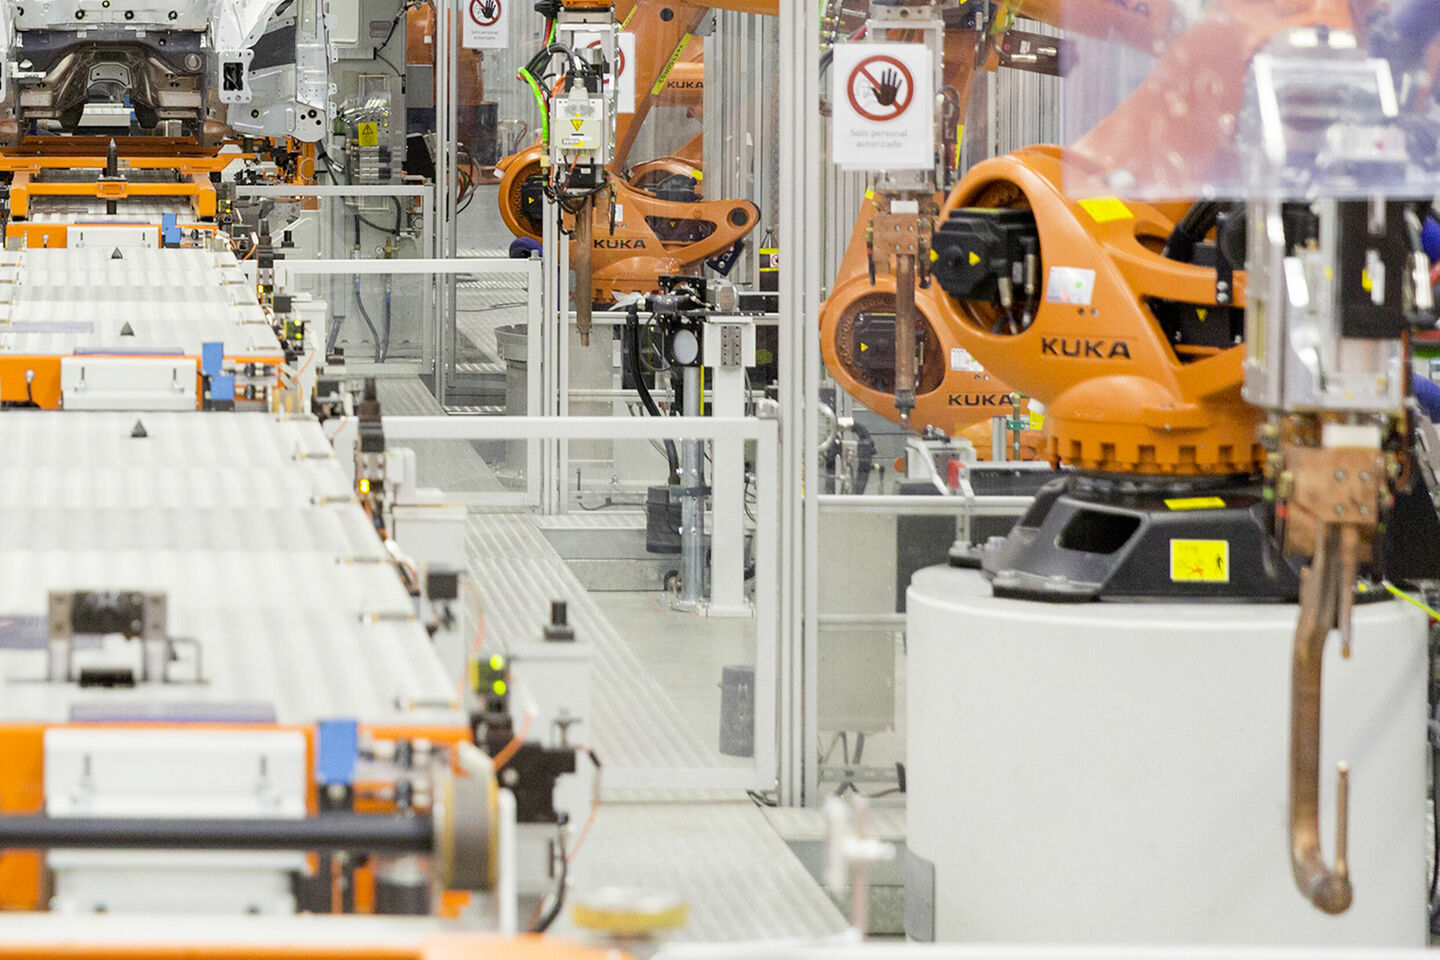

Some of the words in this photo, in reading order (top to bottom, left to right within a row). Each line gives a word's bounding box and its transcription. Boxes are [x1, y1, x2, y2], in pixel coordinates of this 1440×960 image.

[667, 81, 704, 89] KUKA
[594, 239, 646, 249] KUKA
[1041, 336, 1132, 359] KUKA
[948, 394, 1013, 406] KUKA
